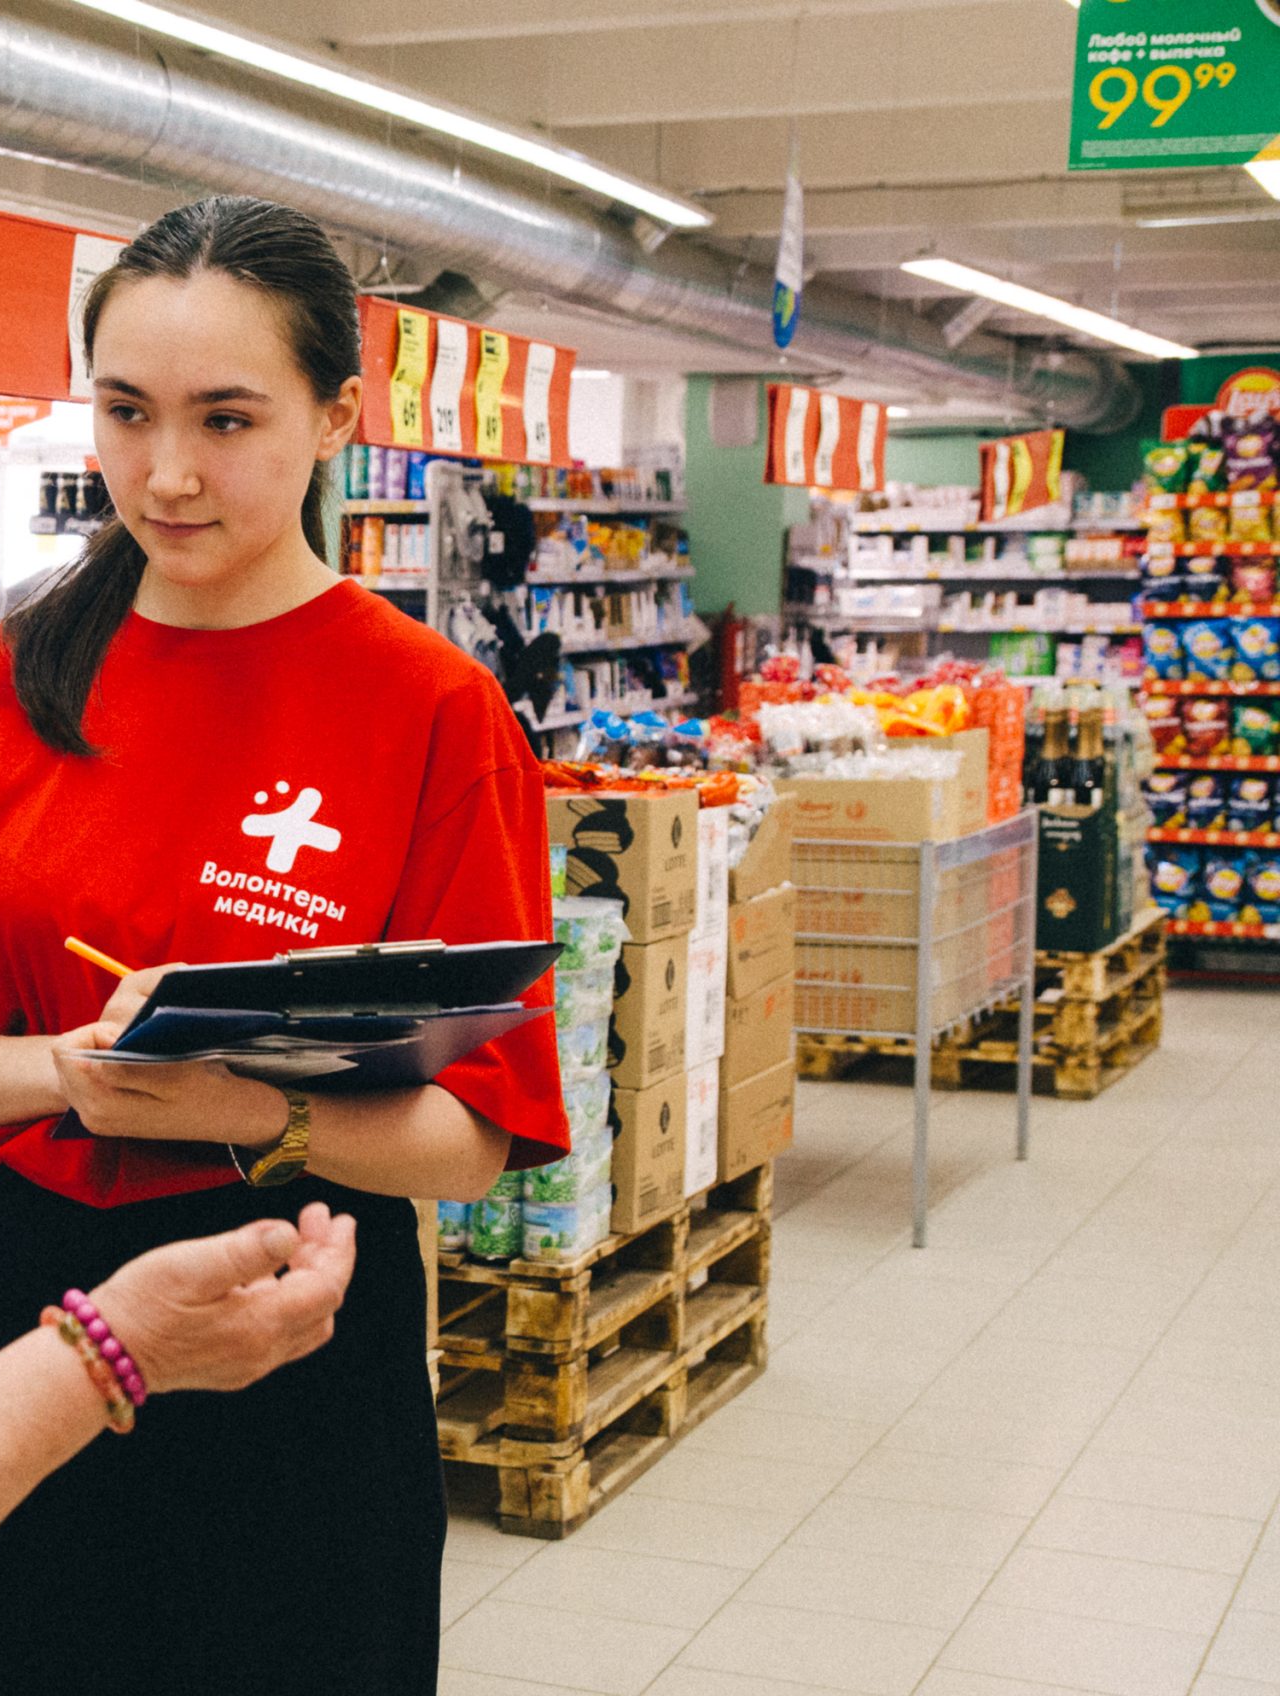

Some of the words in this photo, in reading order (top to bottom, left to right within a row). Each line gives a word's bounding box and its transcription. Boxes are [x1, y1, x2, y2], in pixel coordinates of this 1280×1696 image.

[1087, 47, 1133, 64] кофе
[1149, 45, 1226, 60] выпечка
[1088, 31, 1147, 48] Любой
[1150, 27, 1242, 46] молочный
[1088, 64, 1193, 130] 99
[1193, 61, 1237, 89] 99
[200, 860, 346, 922] Волонтеры
[213, 895, 319, 939] медики
